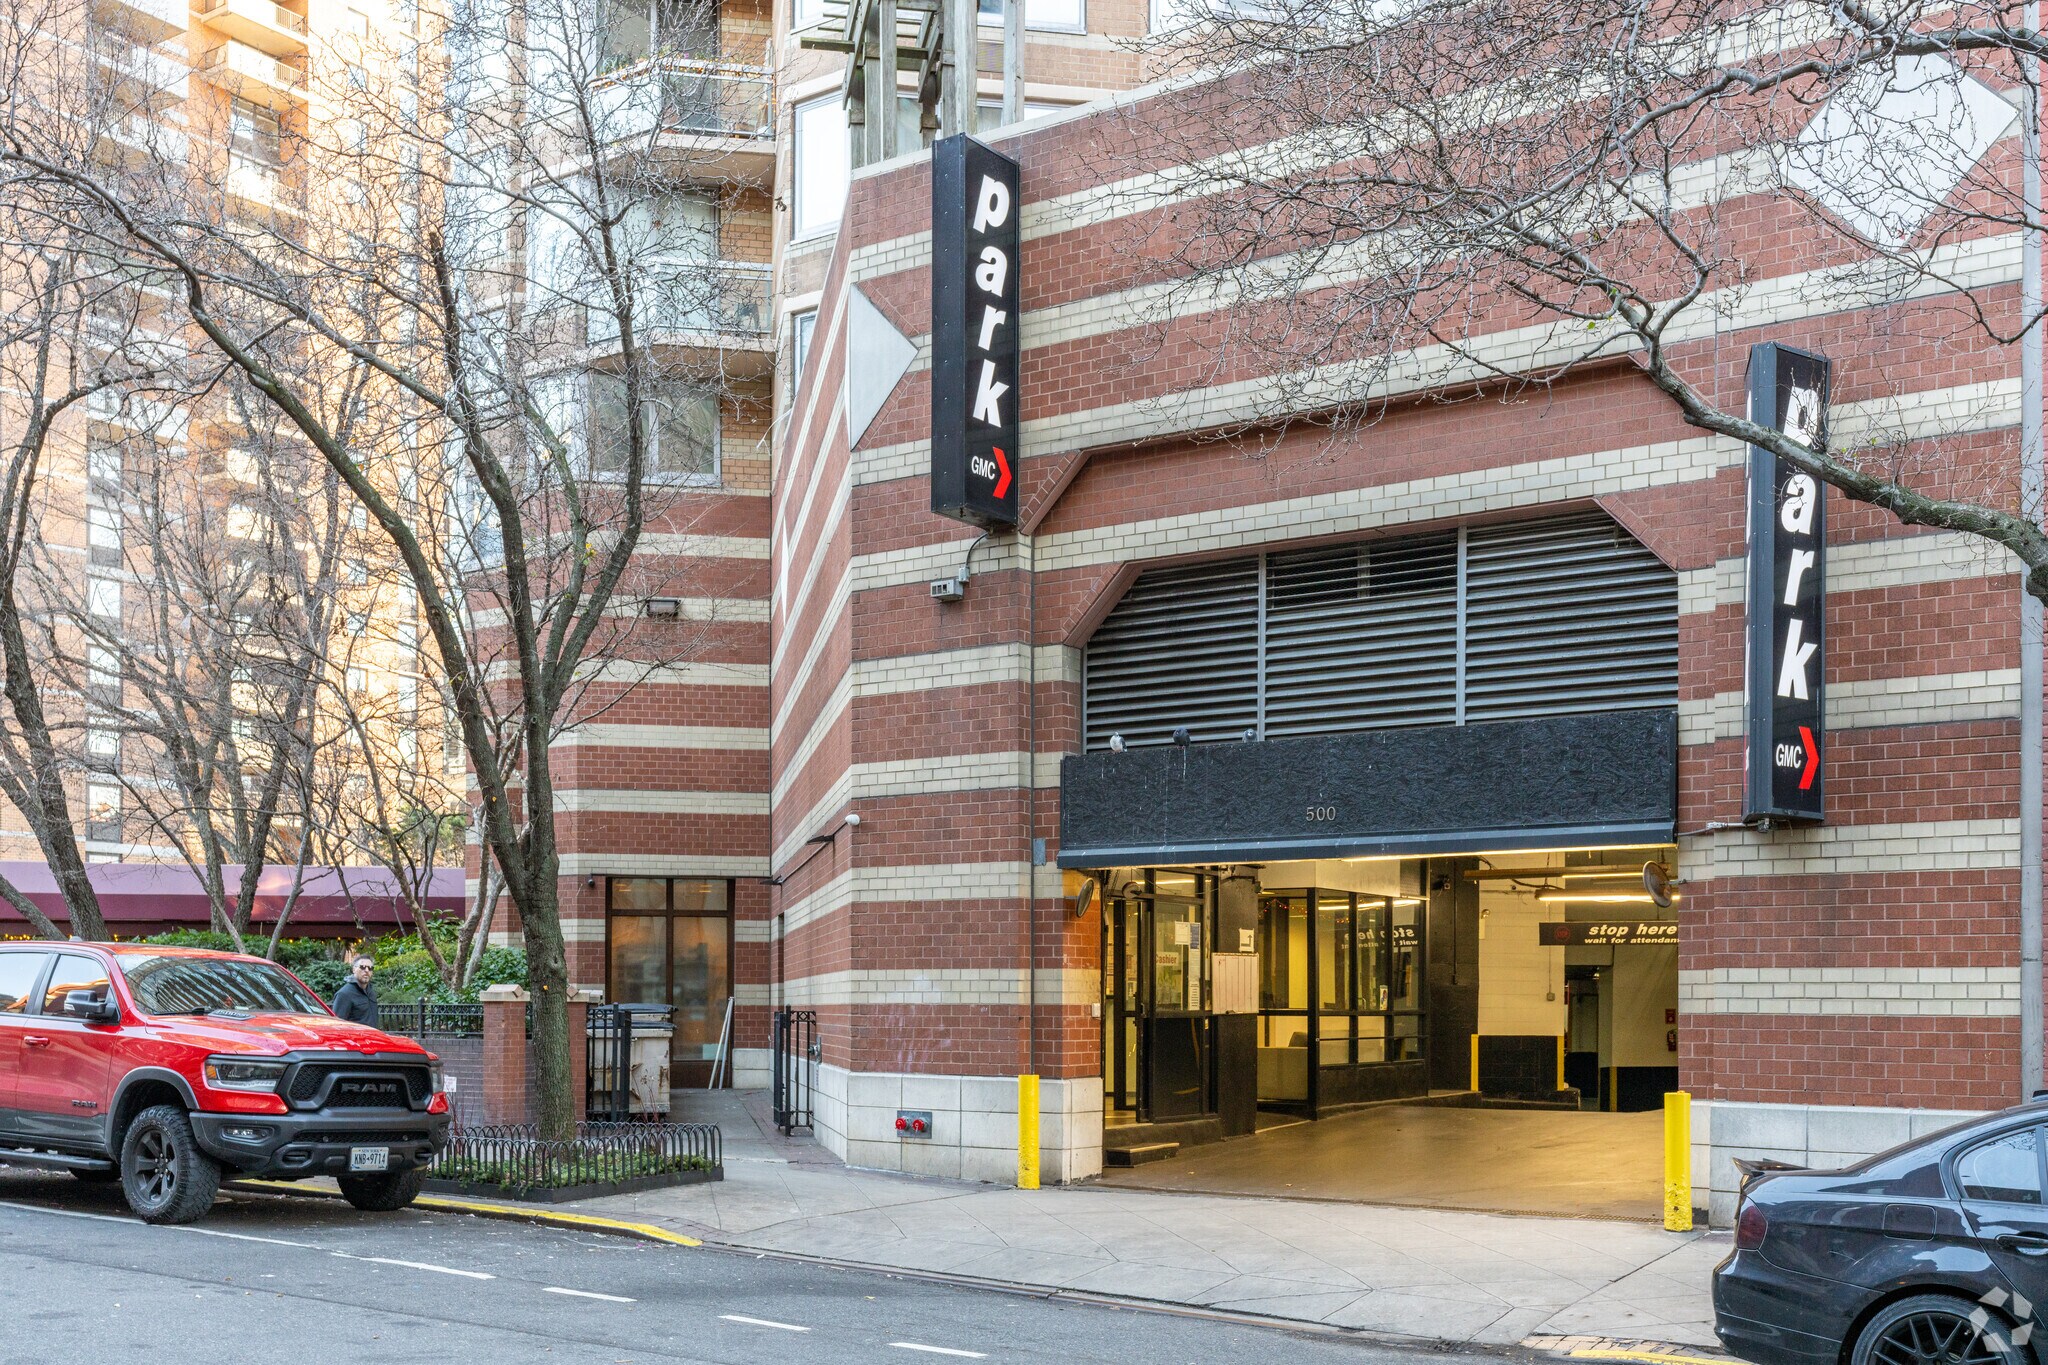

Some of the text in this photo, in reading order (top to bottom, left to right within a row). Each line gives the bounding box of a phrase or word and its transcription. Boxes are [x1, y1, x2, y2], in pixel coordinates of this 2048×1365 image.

[972, 174, 1011, 428] park
[971, 455, 996, 480] GMC
[1777, 386, 1819, 700] park
[1775, 743, 1802, 769] GMC
[1306, 806, 1336, 821] 500
[1589, 923, 1678, 937] stop here
[341, 1083, 397, 1093] RAM
[71, 1099, 98, 1108] RAM
